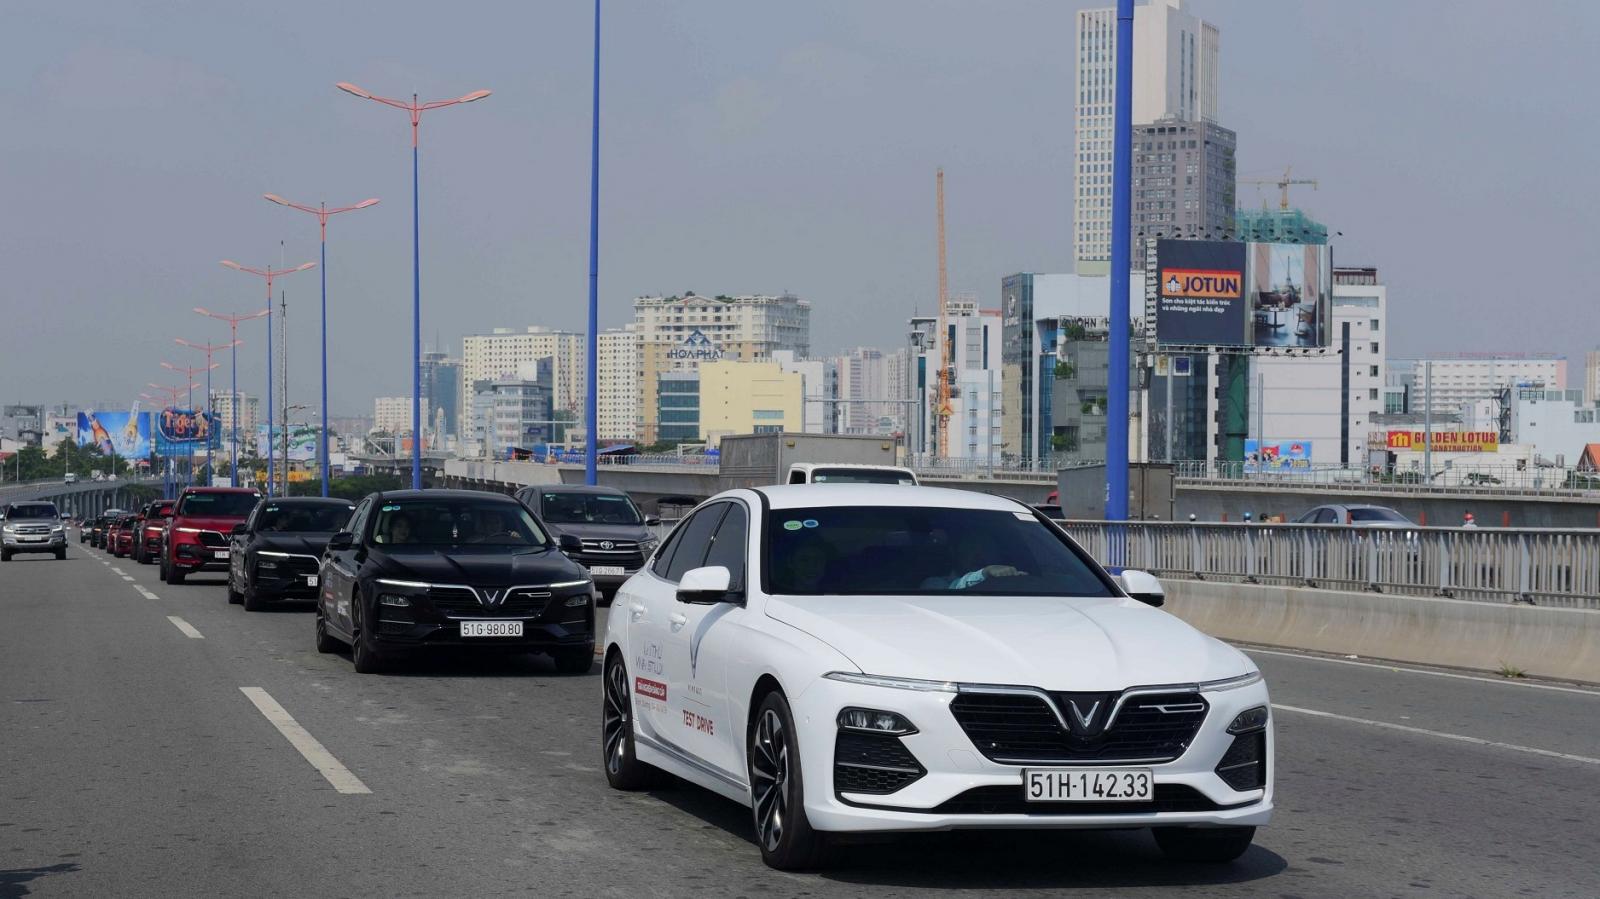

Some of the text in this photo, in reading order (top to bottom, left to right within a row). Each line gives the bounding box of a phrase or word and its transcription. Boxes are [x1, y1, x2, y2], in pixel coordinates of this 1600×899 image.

[1183, 276, 1238, 293] JOTUN
[163, 411, 197, 434] Tiger
[1461, 432, 1496, 444] LOTUS
[463, 623, 521, 635] 51G-980.80
[682, 709, 714, 735] TEST DRIVE
[1031, 773, 1148, 798] 51H-142.33
